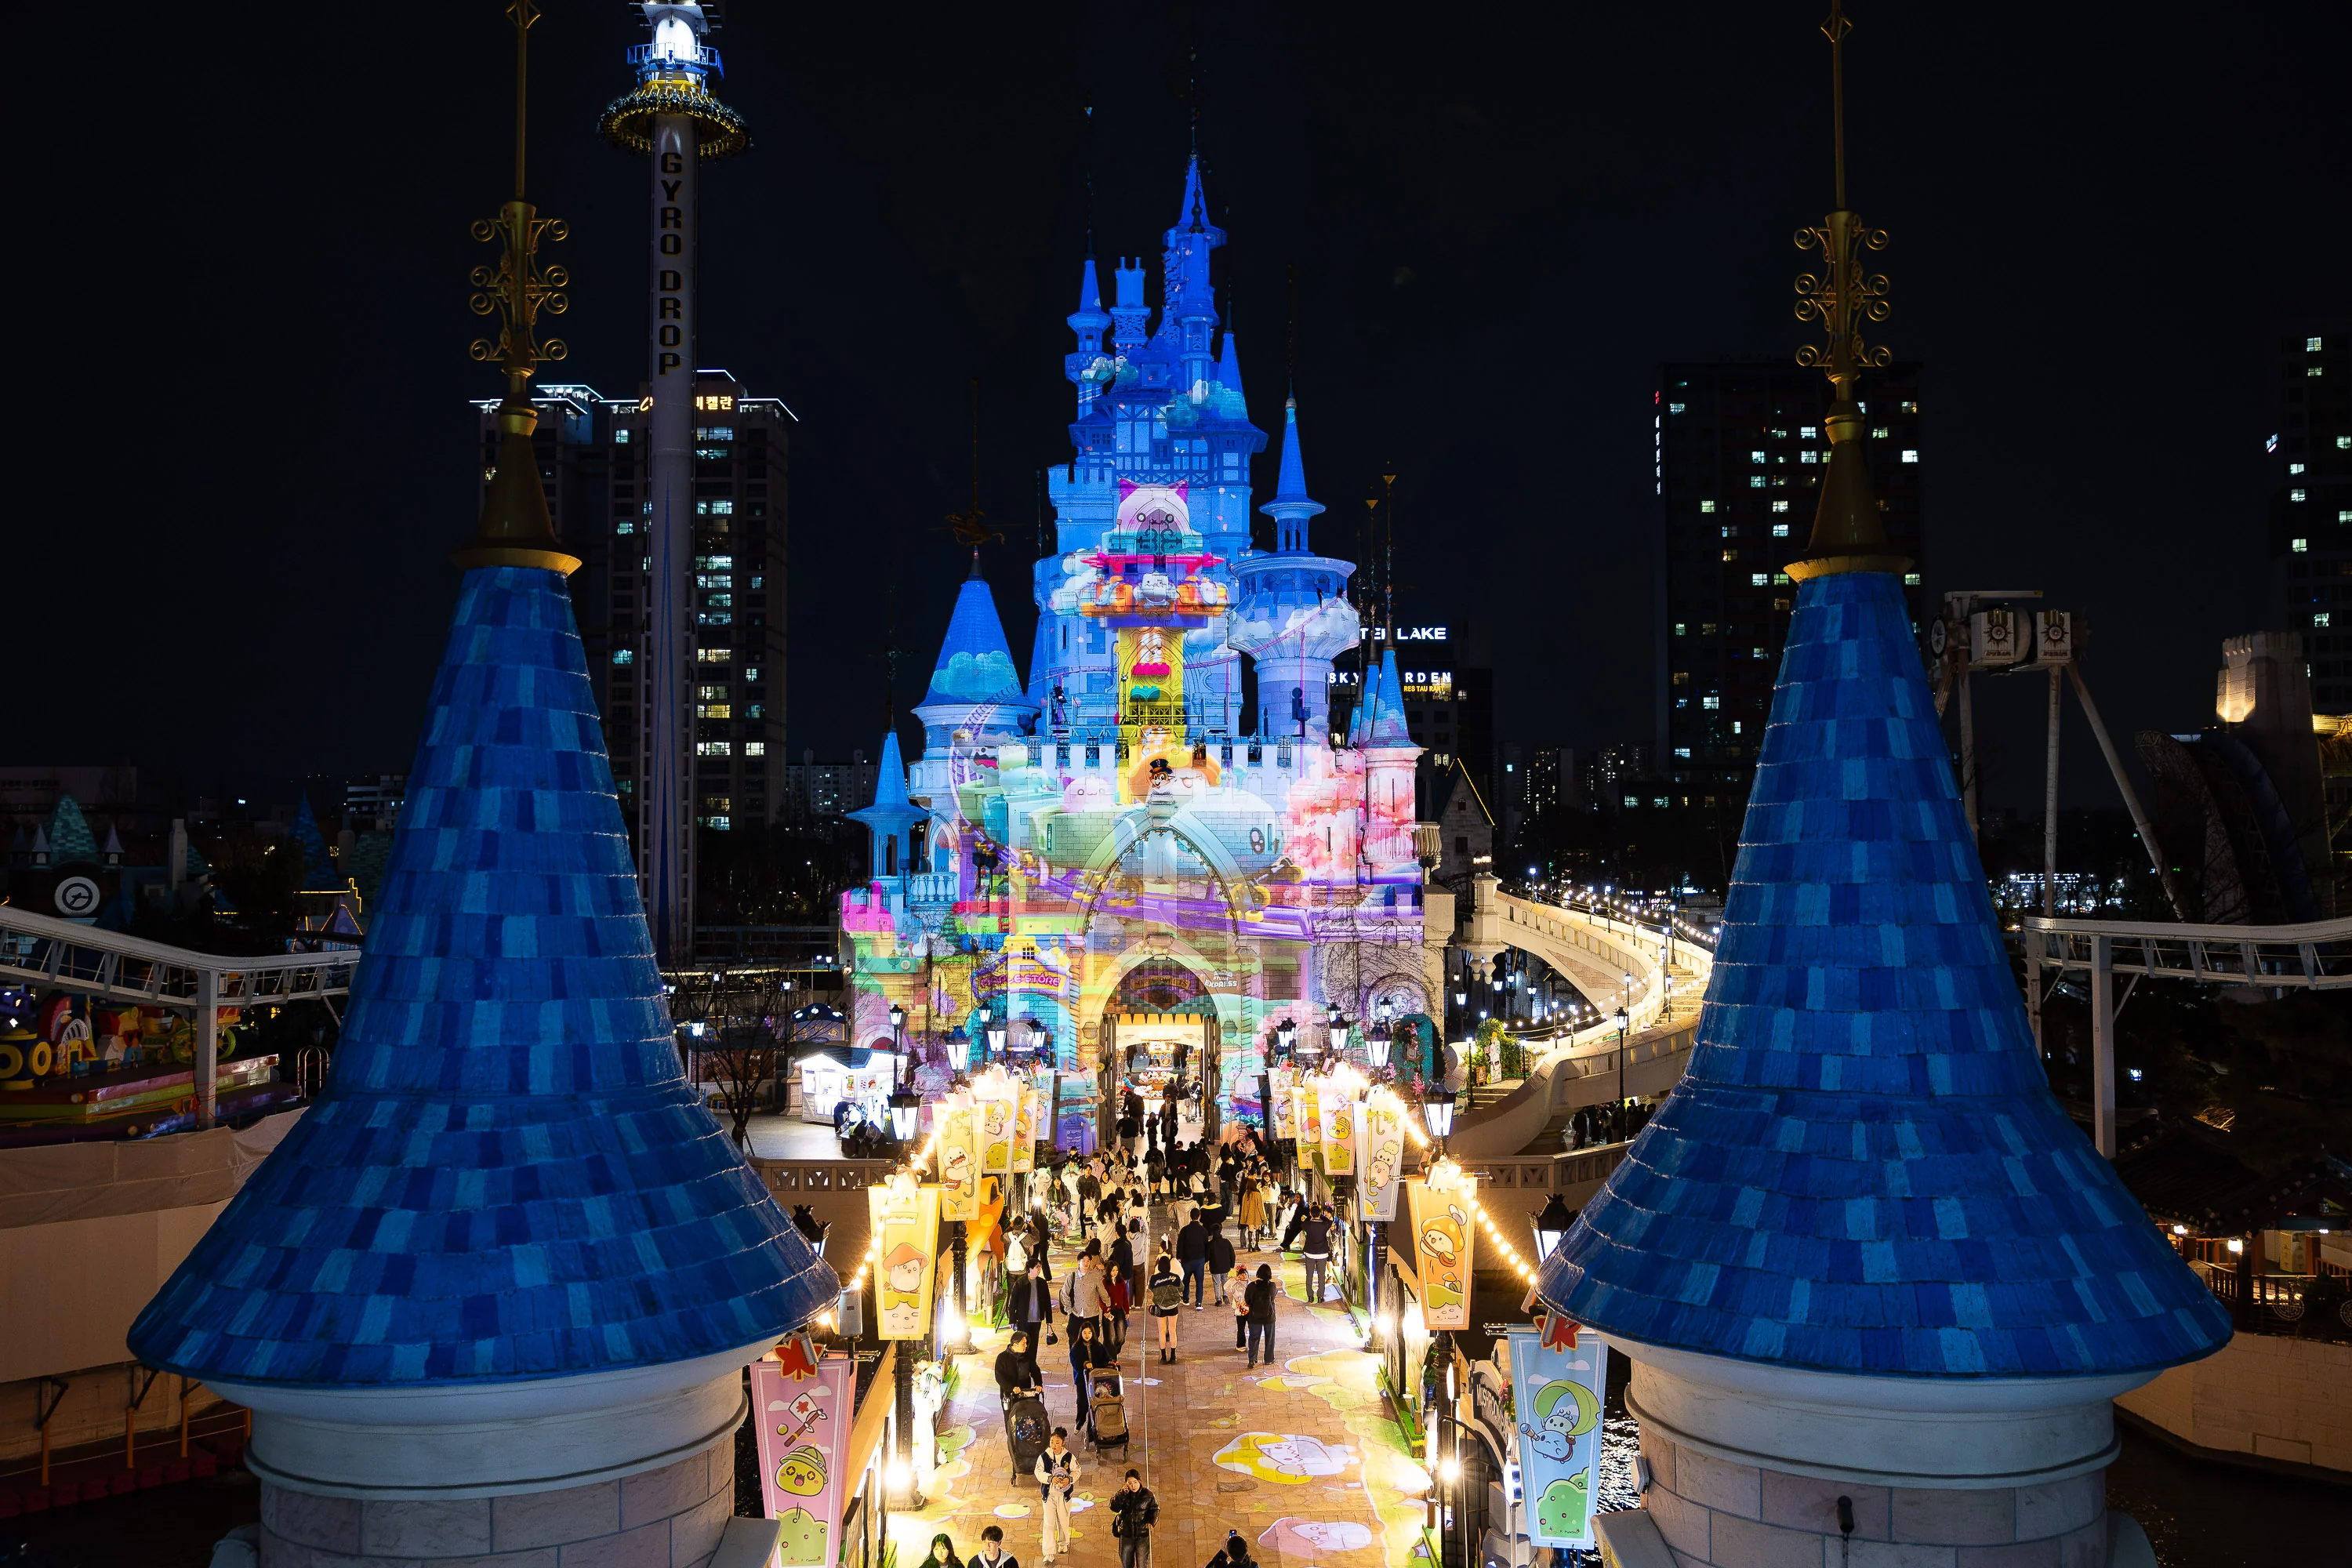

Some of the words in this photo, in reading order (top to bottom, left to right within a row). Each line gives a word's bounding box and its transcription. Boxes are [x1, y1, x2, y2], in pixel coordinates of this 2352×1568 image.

[660, 152, 683, 256] GYRO
[659, 270, 682, 376] DROP
[1359, 627, 1386, 640] TEL
[1397, 627, 1446, 640] LAKE
[1329, 672, 1359, 684] SKY
[1379, 672, 1451, 683] RDEN
[1204, 979, 1238, 988] EXPRESS
